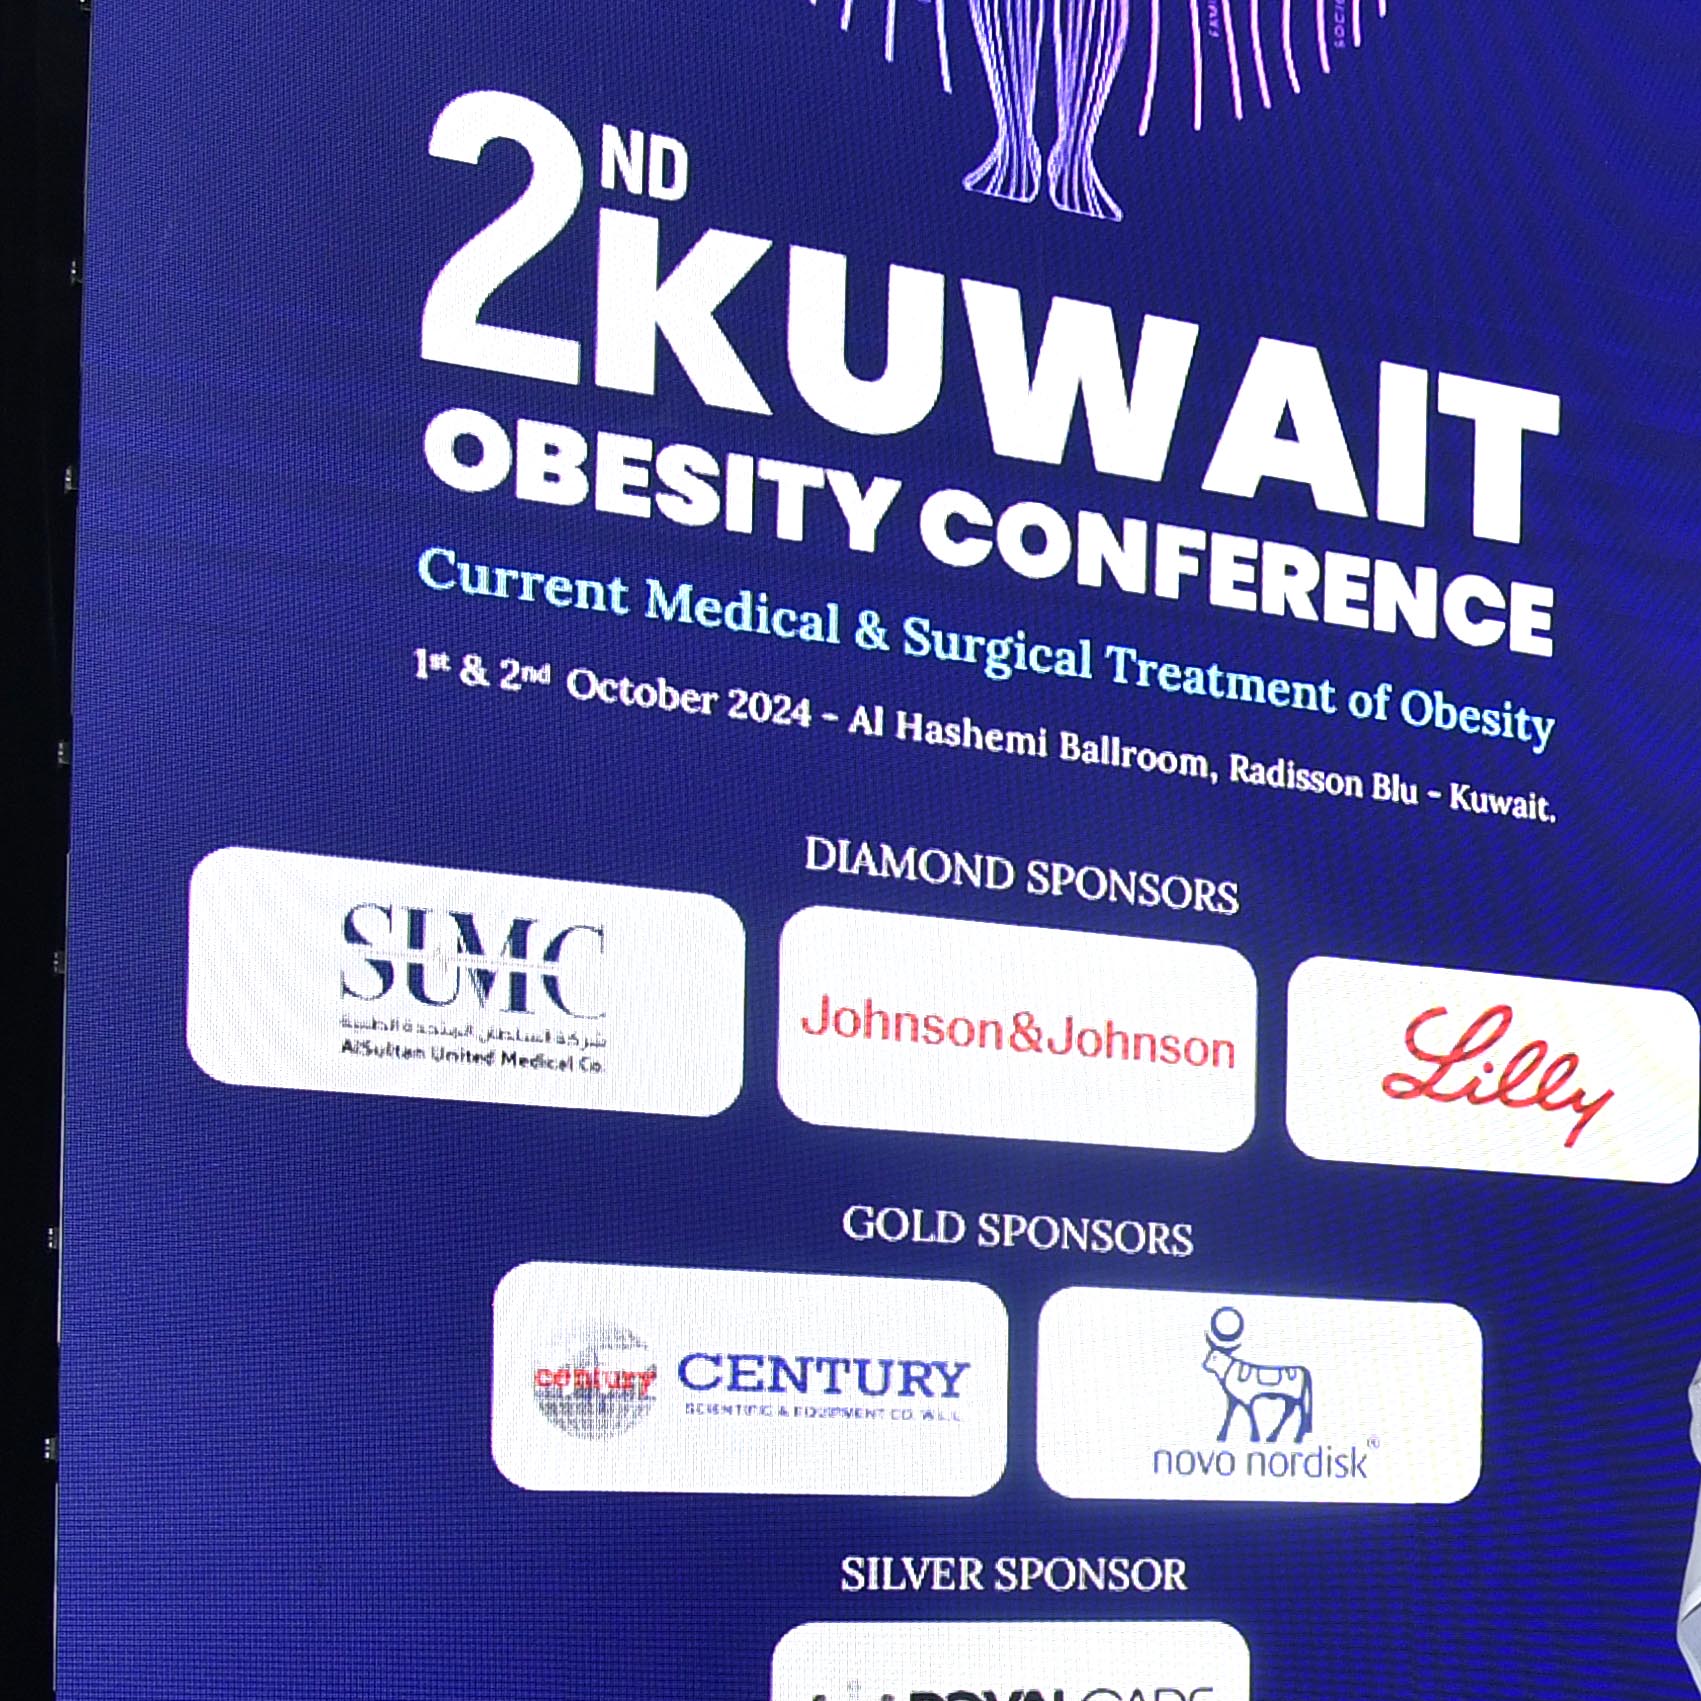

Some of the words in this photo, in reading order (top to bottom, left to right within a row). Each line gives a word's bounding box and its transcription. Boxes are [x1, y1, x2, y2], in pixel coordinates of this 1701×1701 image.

[595, 208, 1560, 543] KUWAIT
[424, 408, 901, 552] OBESITY
[920, 489, 1553, 659] CONFERENCE
[418, 547, 629, 615] Current
[645, 579, 840, 644] Medical
[855, 610, 890, 651] &
[904, 617, 1092, 680] Surgical
[1105, 645, 1337, 714] Treatment
[1349, 682, 1392, 721] of
[1401, 690, 1556, 754] Obesity
[414, 648, 452, 680] 1st
[459, 653, 491, 687] &
[500, 658, 551, 692] 2nd
[566, 667, 719, 715] October
[727, 688, 811, 728] 2024
[848, 705, 884, 737] Al
[896, 710, 1048, 758] Hashemi
[1060, 730, 1218, 784] Ballroom,
[1230, 753, 1364, 798] Radisson
[1372, 772, 1419, 805] Blu
[1450, 782, 1556, 823] Kuwait.
[805, 836, 1014, 890] DIAMOND
[1027, 861, 1240, 916] SPONSORS
[800, 993, 1236, 1069] Johnson&Johnson
[1381, 1004, 1615, 1148] Lilly
[842, 1205, 966, 1243] GOLD
[977, 1213, 1194, 1258] SPONSORS
[678, 1352, 972, 1399] CENTURY
[1153, 1448, 1236, 1477] novo
[841, 1556, 985, 1592] SILVER
[994, 1557, 1188, 1592] SPONSOR
